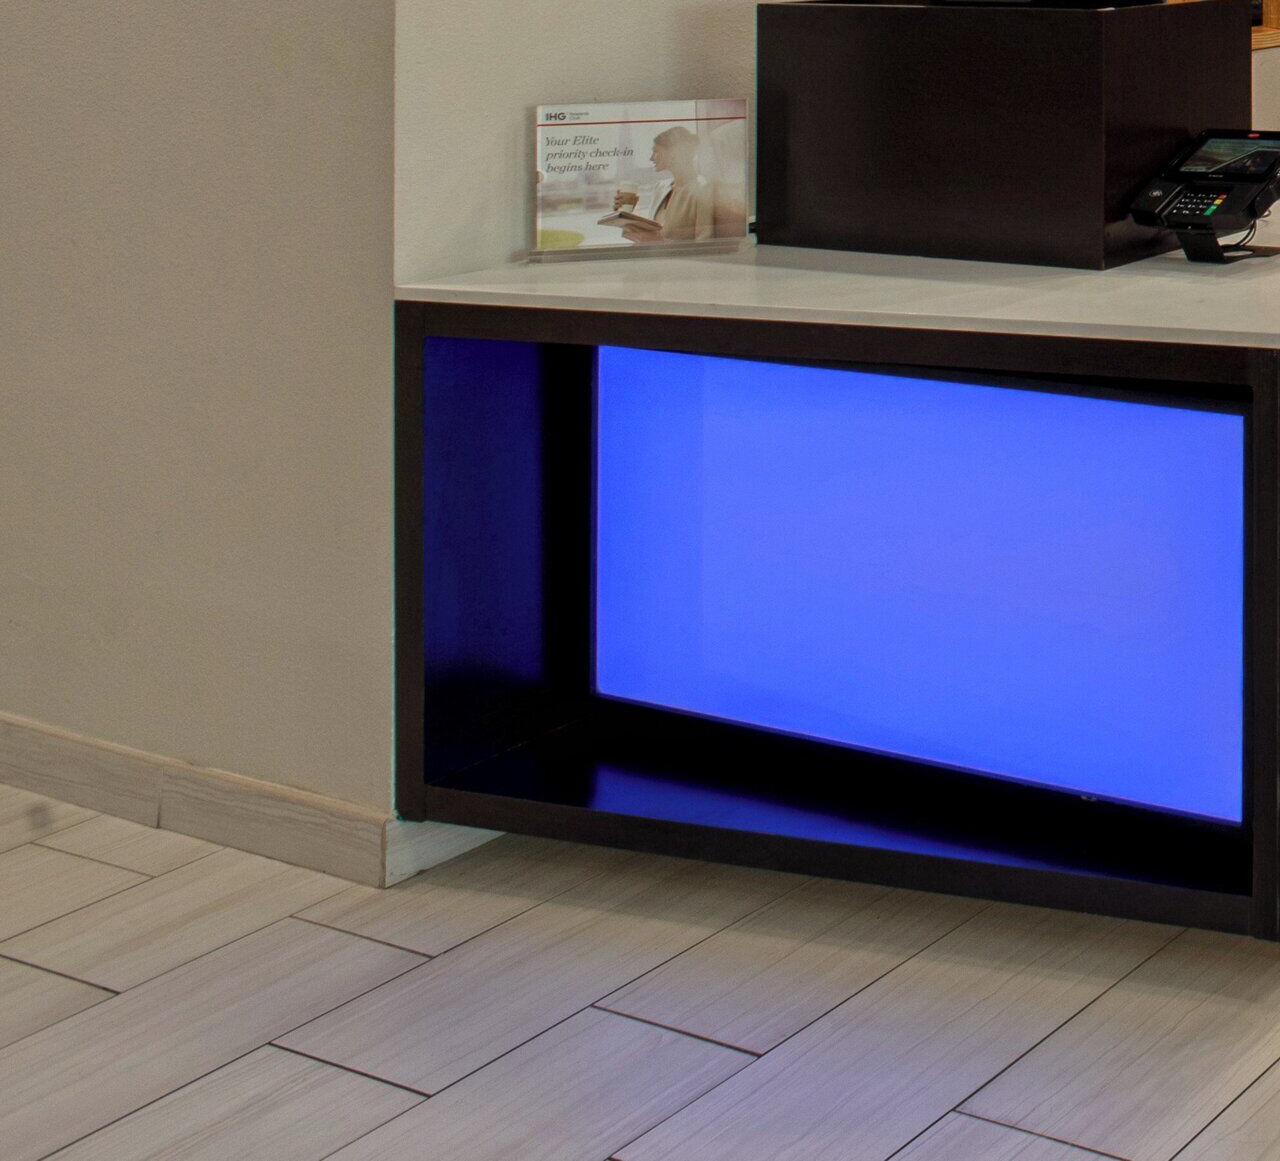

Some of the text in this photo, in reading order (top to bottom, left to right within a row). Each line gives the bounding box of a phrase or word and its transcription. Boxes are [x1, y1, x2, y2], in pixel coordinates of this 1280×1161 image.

[546, 112, 567, 121] IHG
[545, 135, 600, 147] Your Elite
[546, 146, 634, 161] priority check-in
[546, 161, 610, 174] begins here
